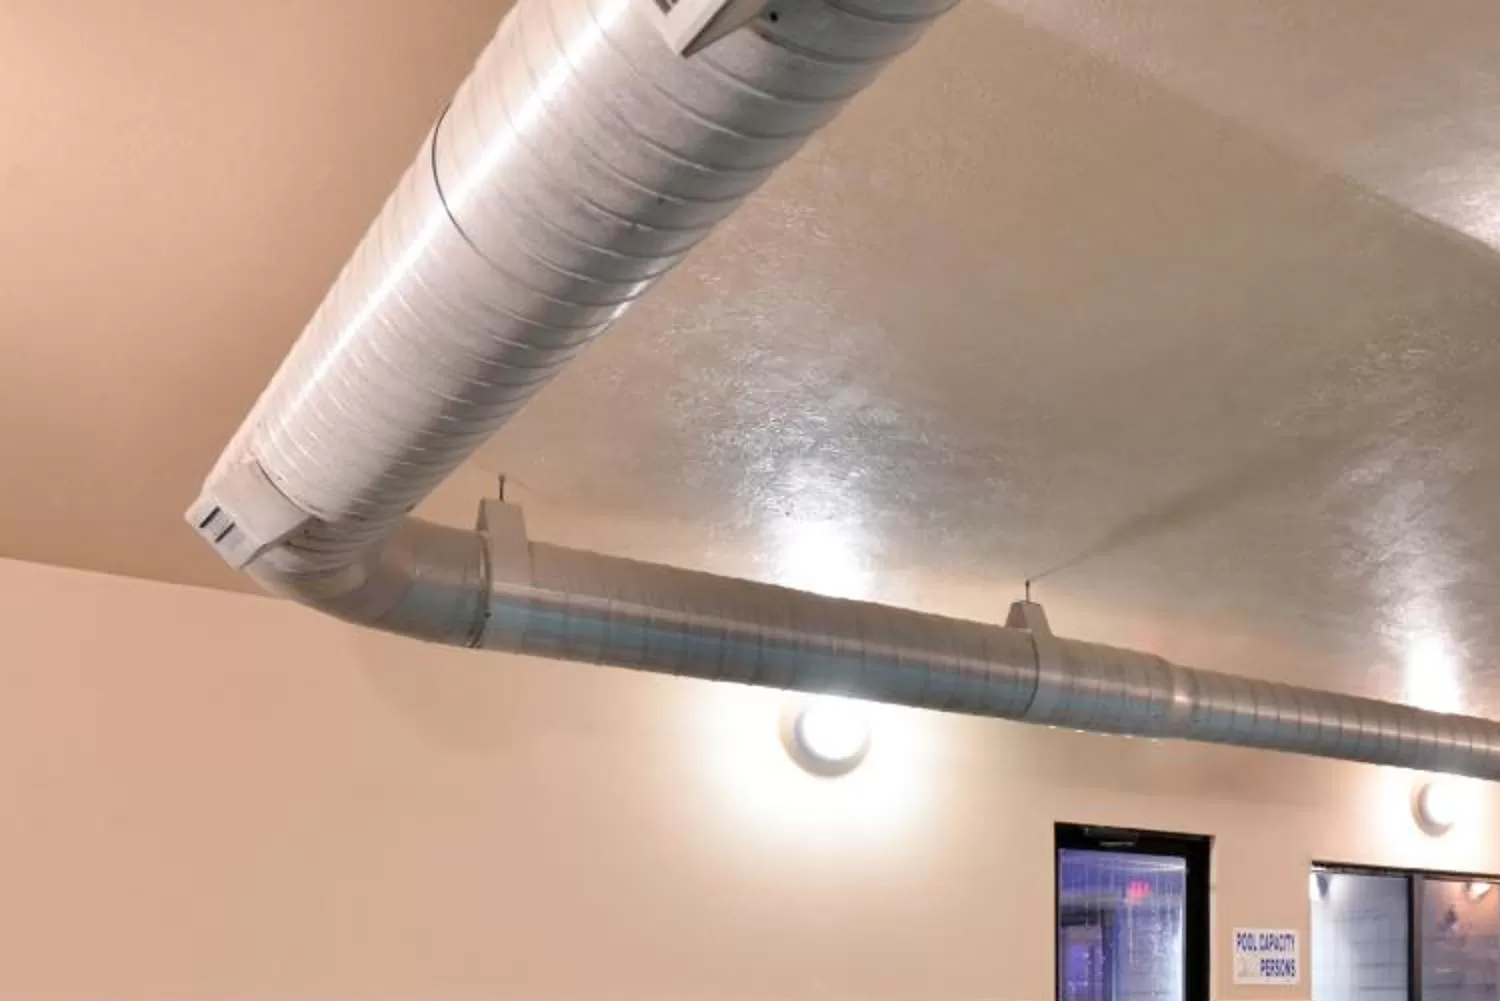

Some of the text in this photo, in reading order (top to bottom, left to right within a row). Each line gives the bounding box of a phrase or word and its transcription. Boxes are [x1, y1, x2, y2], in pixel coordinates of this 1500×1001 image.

[1237, 932, 1295, 952] POOL CAPACITY
[1260, 958, 1295, 977] PERSONS
